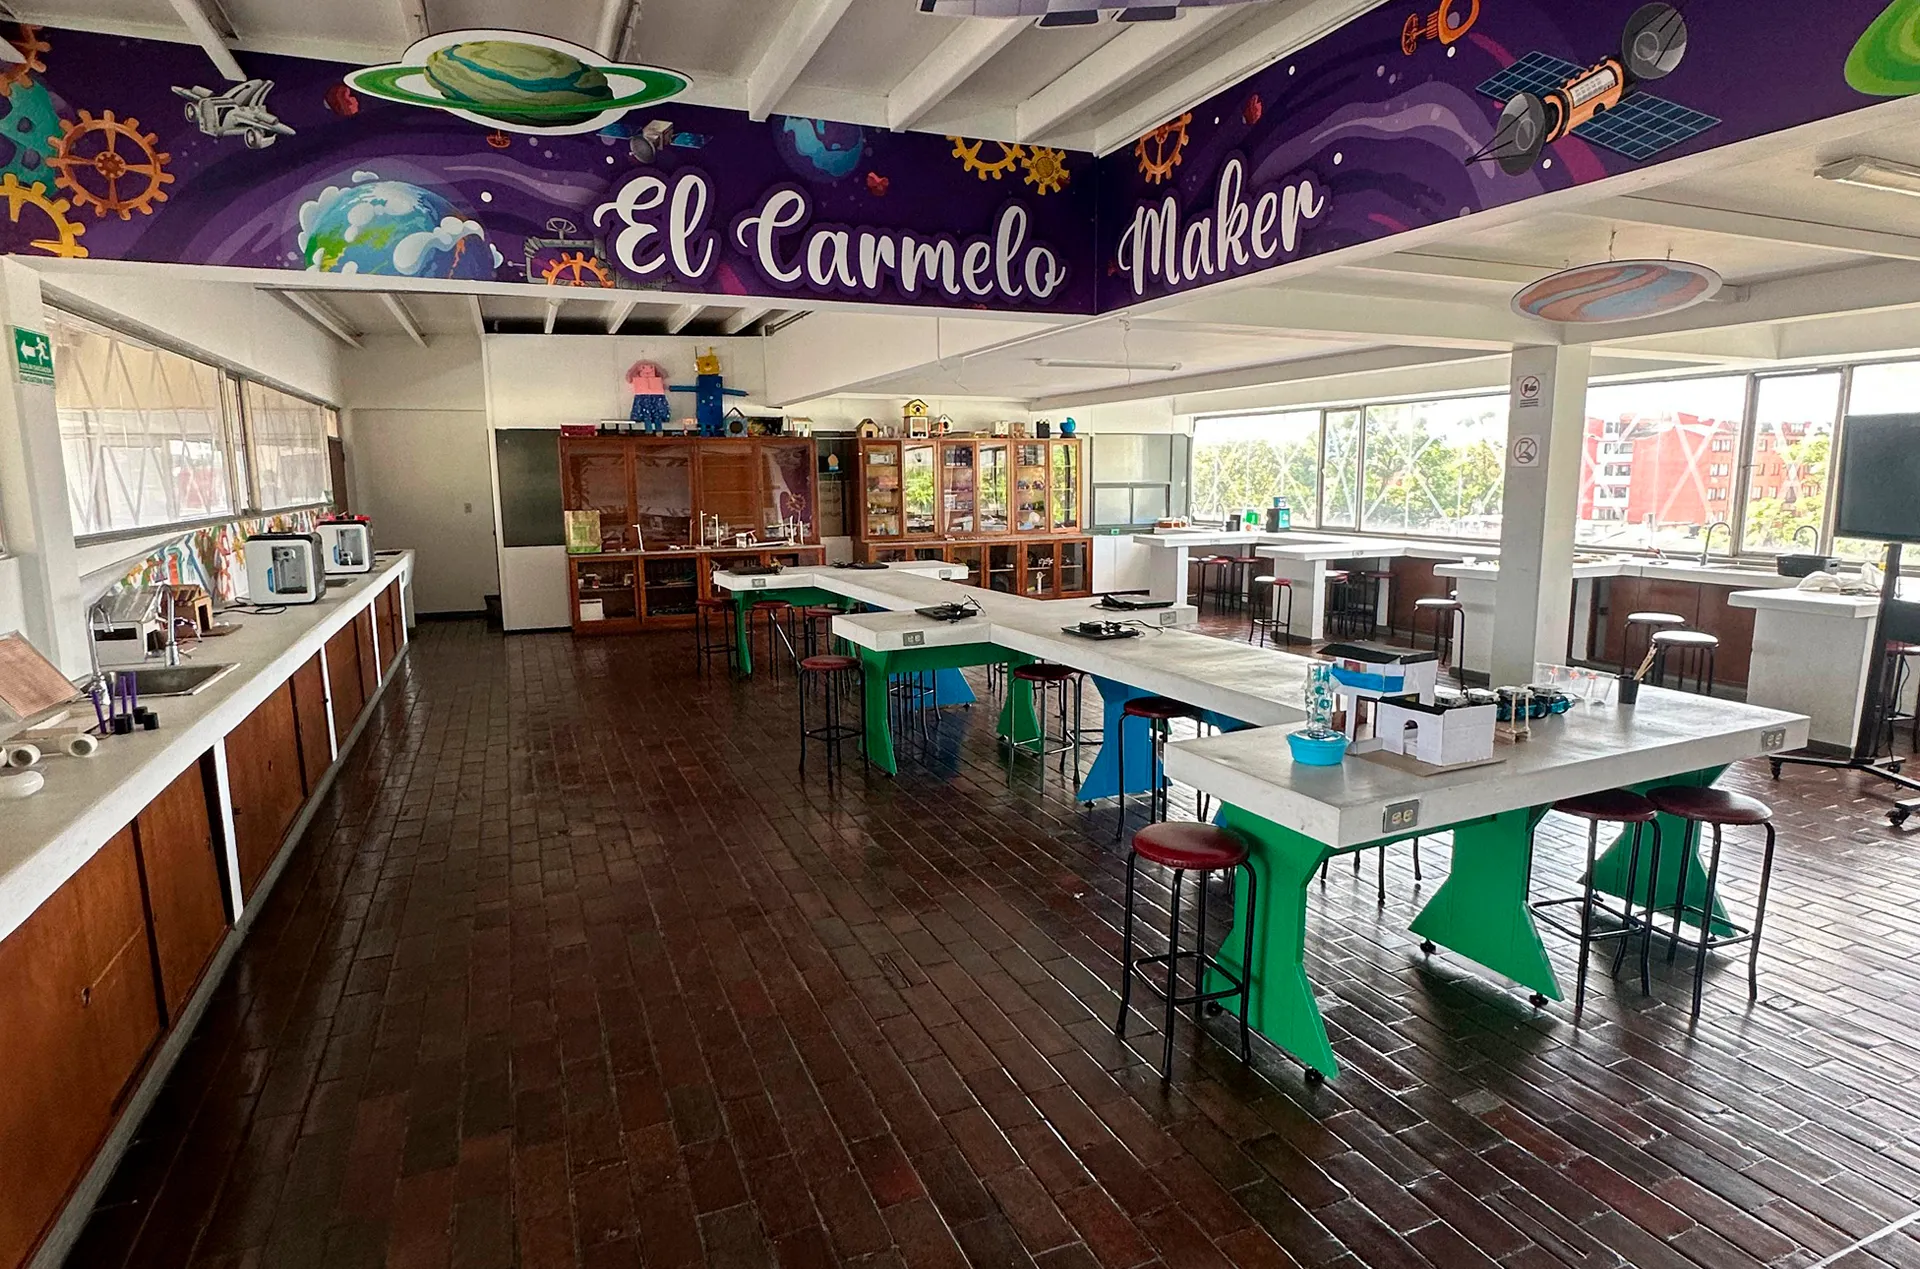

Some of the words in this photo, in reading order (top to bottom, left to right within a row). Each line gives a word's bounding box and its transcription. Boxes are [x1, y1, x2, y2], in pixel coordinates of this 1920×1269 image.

[593, 174, 713, 278] El
[737, 190, 1066, 299] Carmelo
[1118, 159, 1324, 295] Maker
